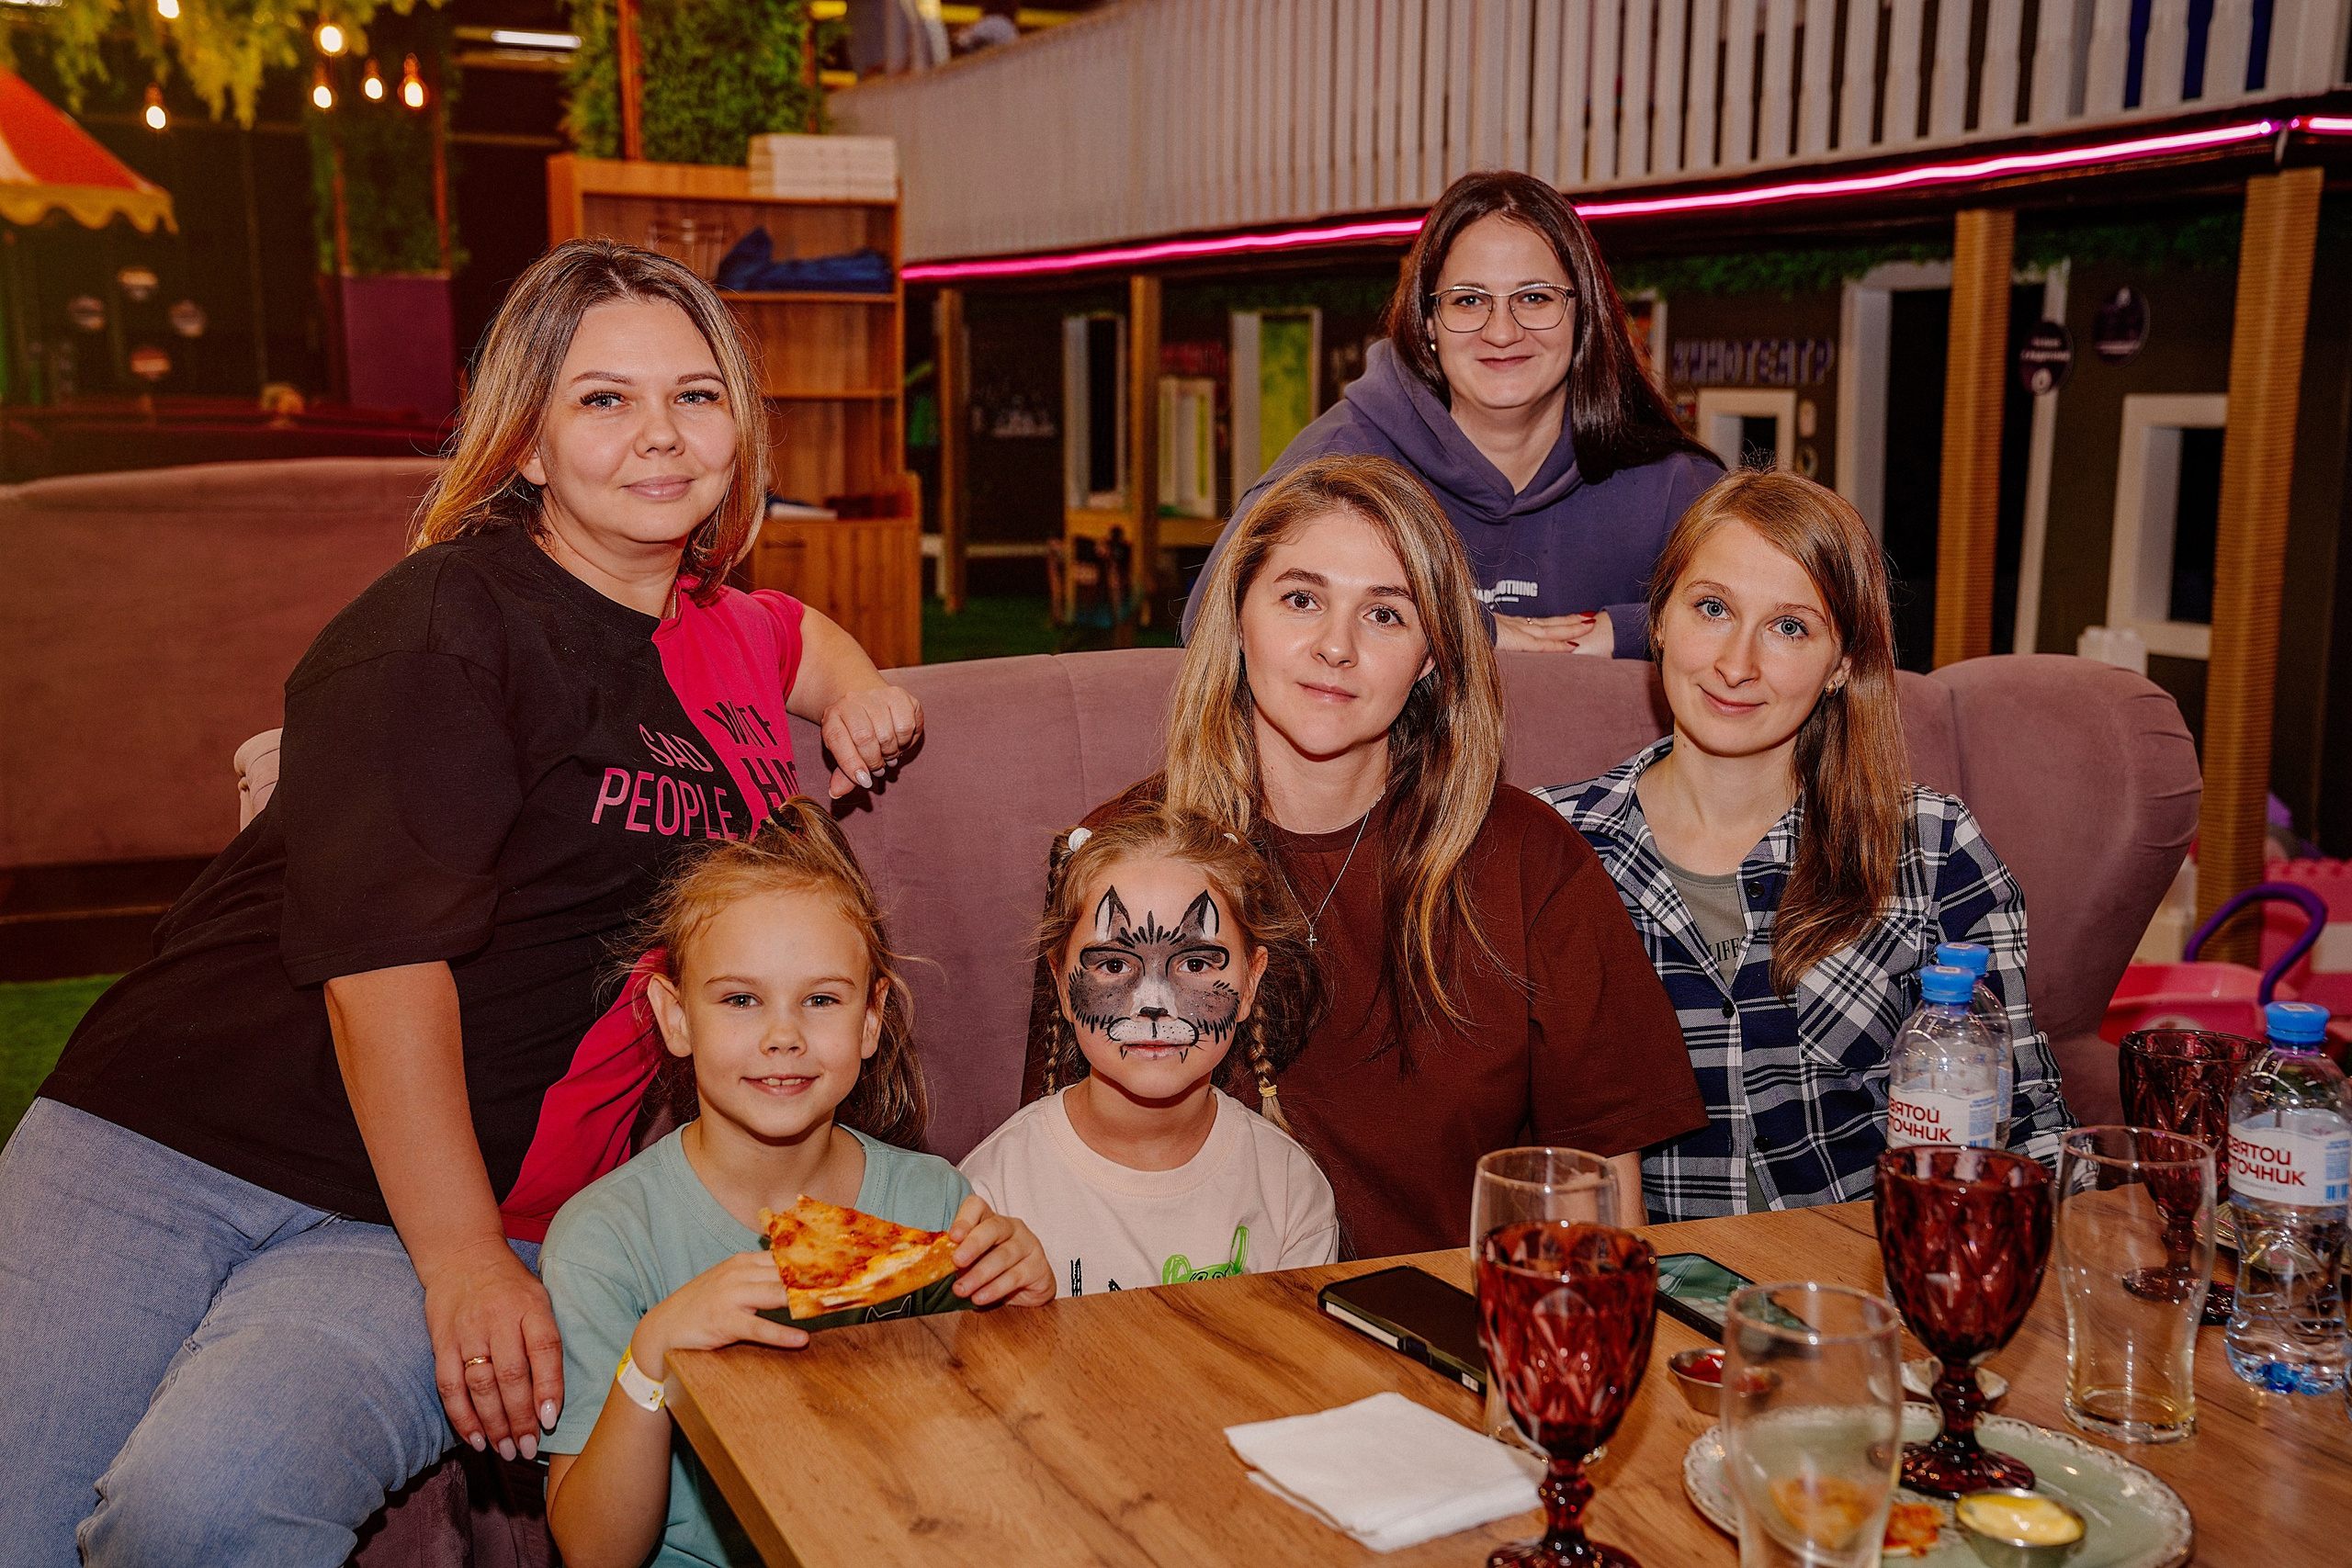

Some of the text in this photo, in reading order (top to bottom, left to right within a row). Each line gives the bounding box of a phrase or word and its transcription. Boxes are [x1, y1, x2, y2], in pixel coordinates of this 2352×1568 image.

[639, 723, 714, 773] SAD
[591, 767, 739, 840] PEOPLE
[1889, 1097, 1940, 1124] ВЯТОЙ
